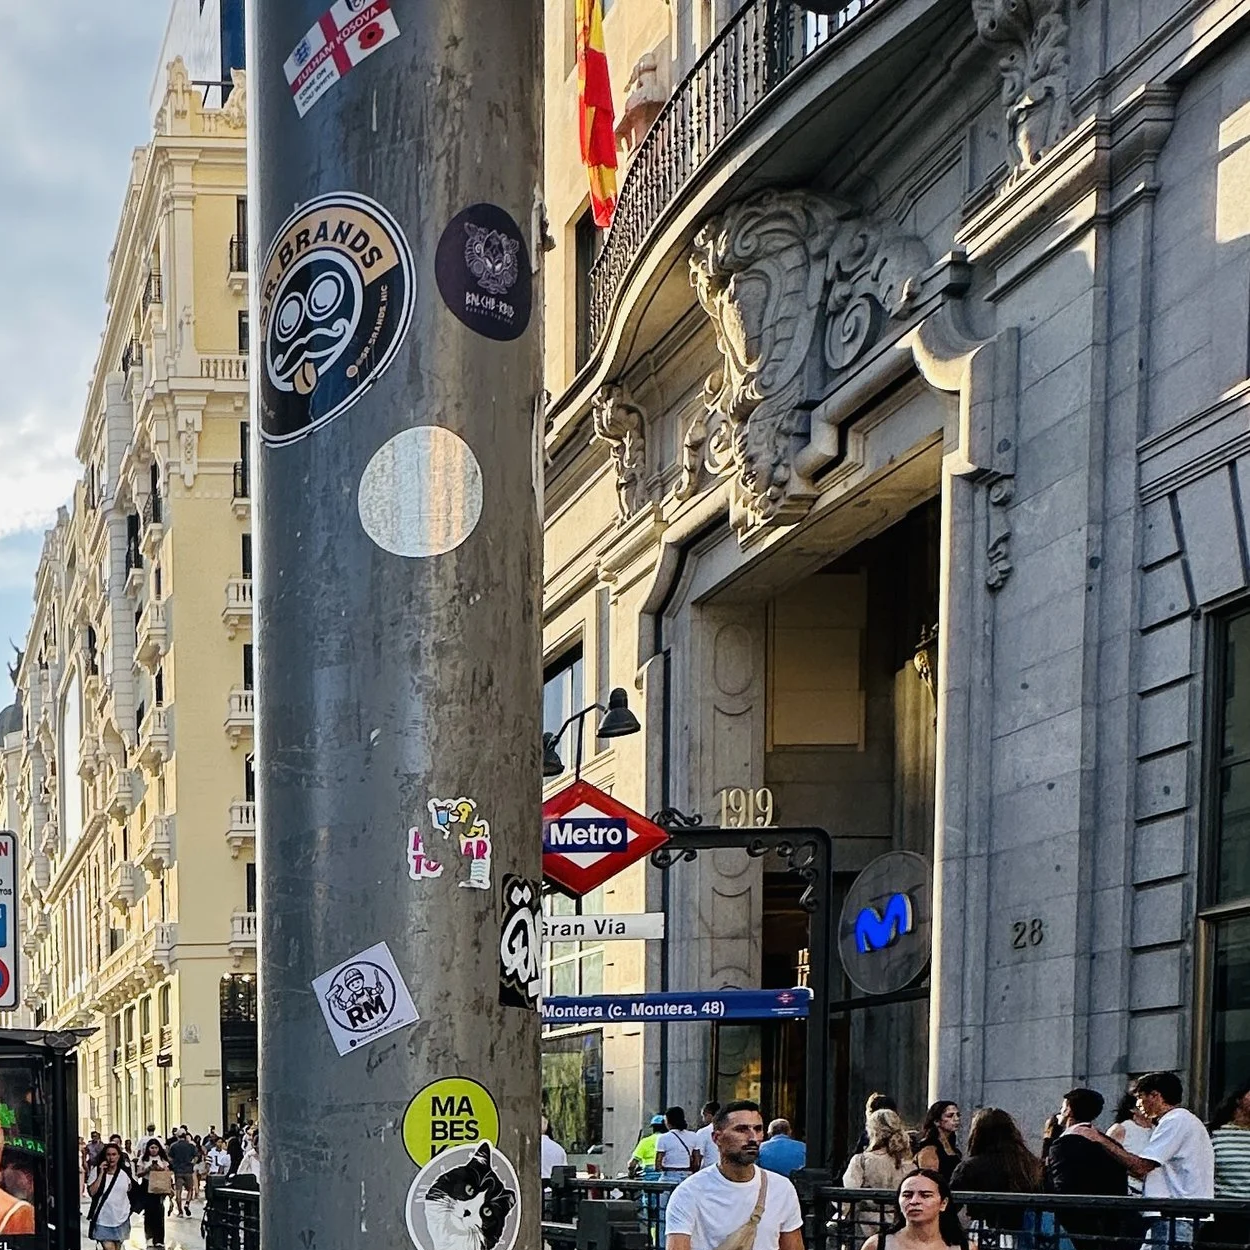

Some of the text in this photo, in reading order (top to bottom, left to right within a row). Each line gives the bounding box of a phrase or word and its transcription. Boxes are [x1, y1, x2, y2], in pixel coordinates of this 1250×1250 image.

[297, 7, 379, 85] FULHAM KOSOVA
[719, 787, 774, 828] 1919
[550, 823, 622, 845] Metro
[593, 919, 626, 935] Via
[1012, 918, 1044, 949] 28
[345, 994, 388, 1029] RM
[542, 1000, 725, 1019] Montera (c. Montera, 48)
[431, 1096, 474, 1117] MA
[431, 1120, 479, 1141] BES
